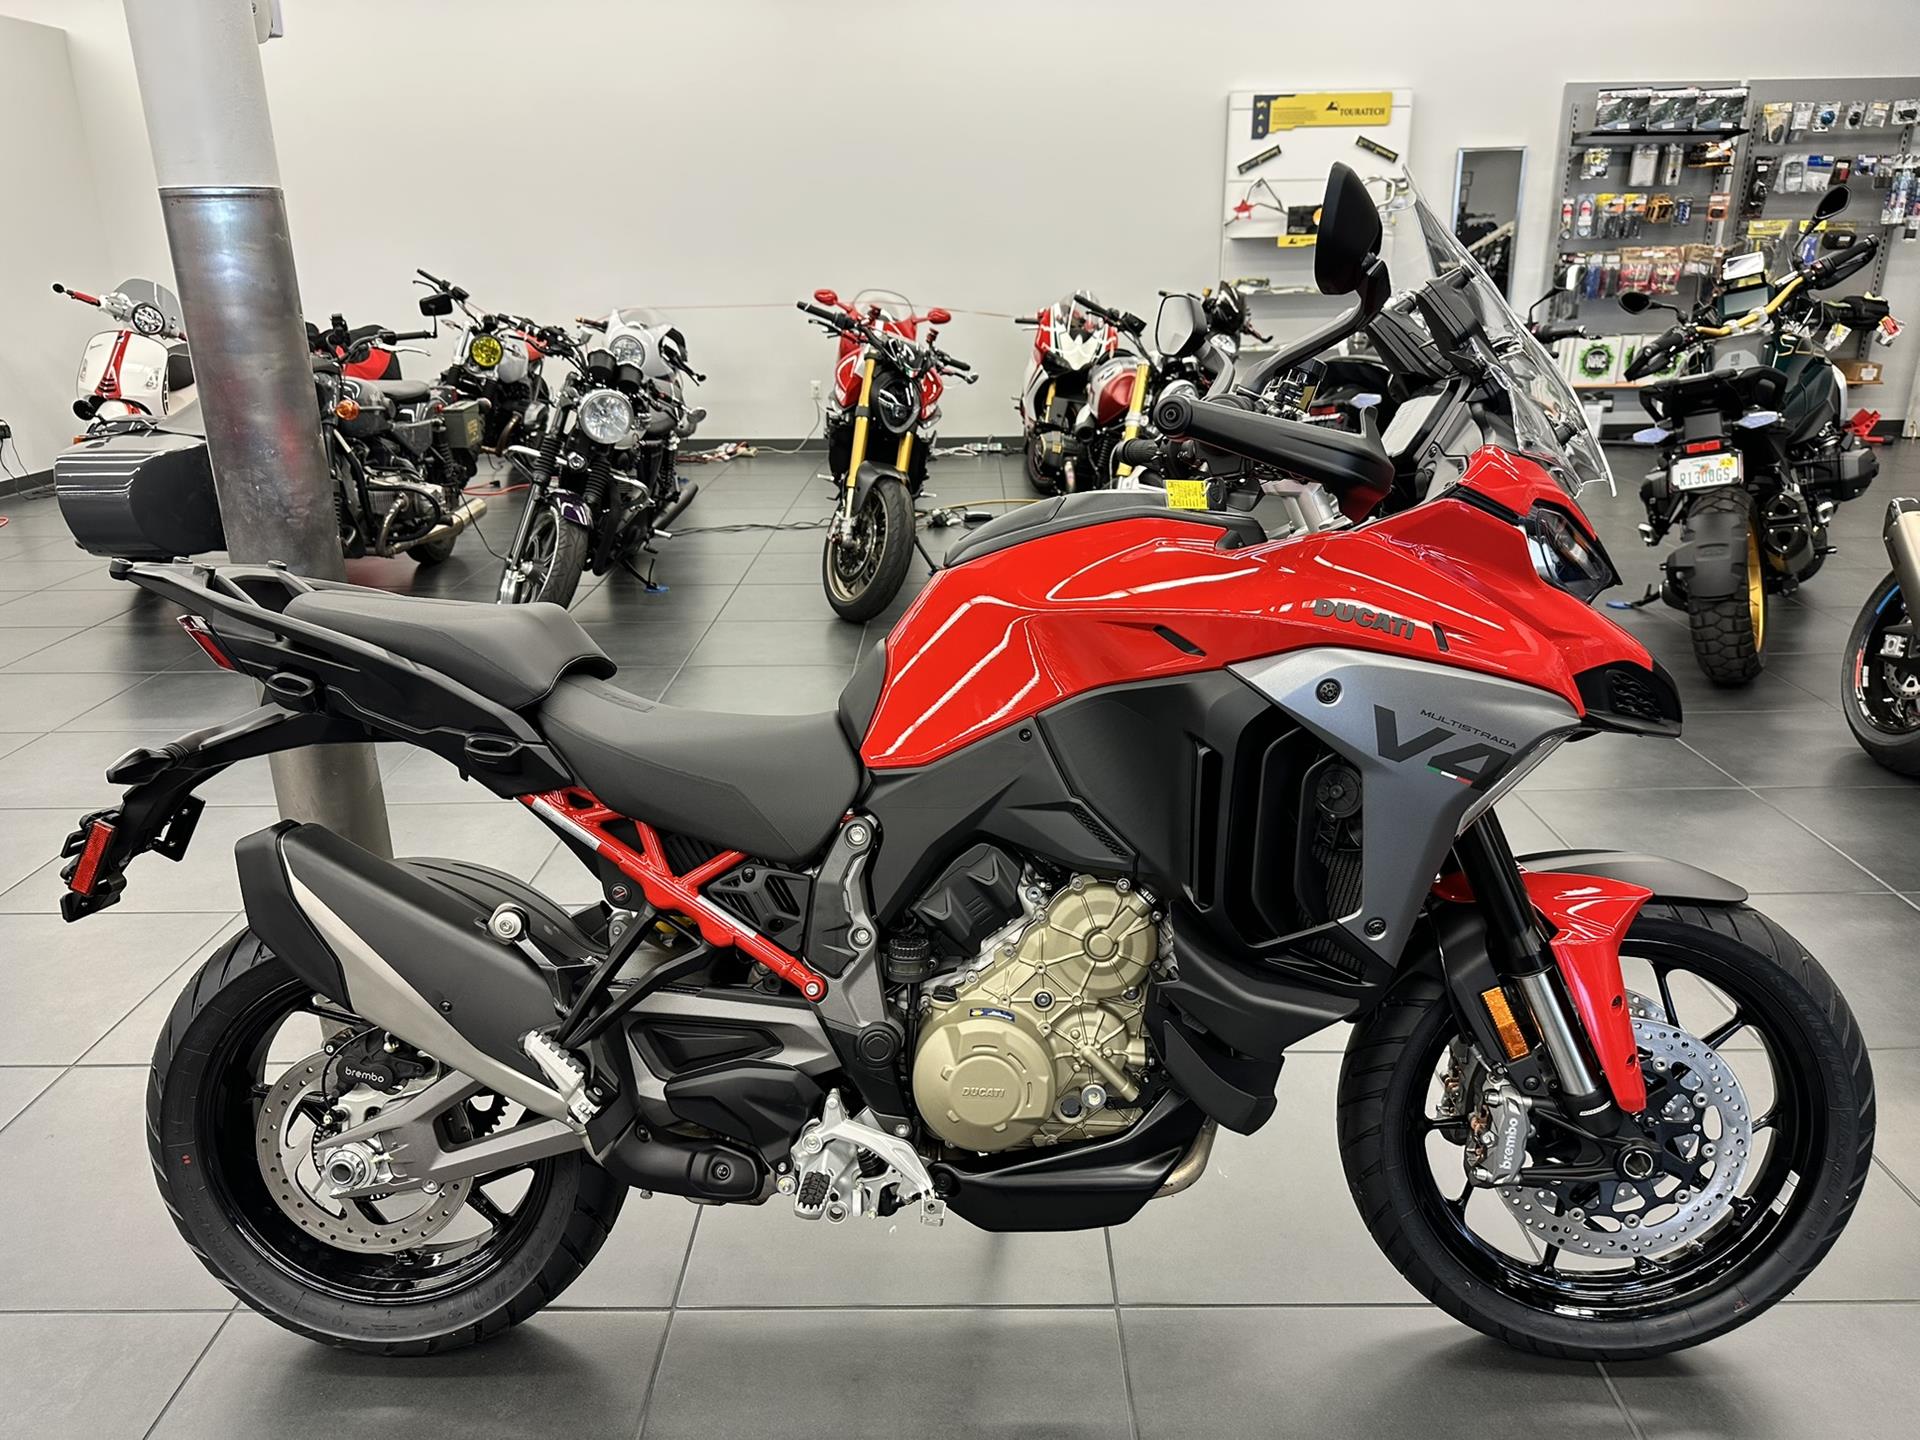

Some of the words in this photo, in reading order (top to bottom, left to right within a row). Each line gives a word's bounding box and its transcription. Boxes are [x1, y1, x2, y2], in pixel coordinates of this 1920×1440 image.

[1339, 107, 1386, 117] TOURATECH
[1679, 467, 1730, 487] R1300GS
[1313, 598, 1416, 640] DUCATI
[1420, 709, 1517, 749] MULTISTRADA
[1374, 704, 1512, 791] V4
[345, 1066, 385, 1083] brembo
[961, 1087, 1005, 1098] DUCATI
[1499, 1117, 1519, 1170] brembo
